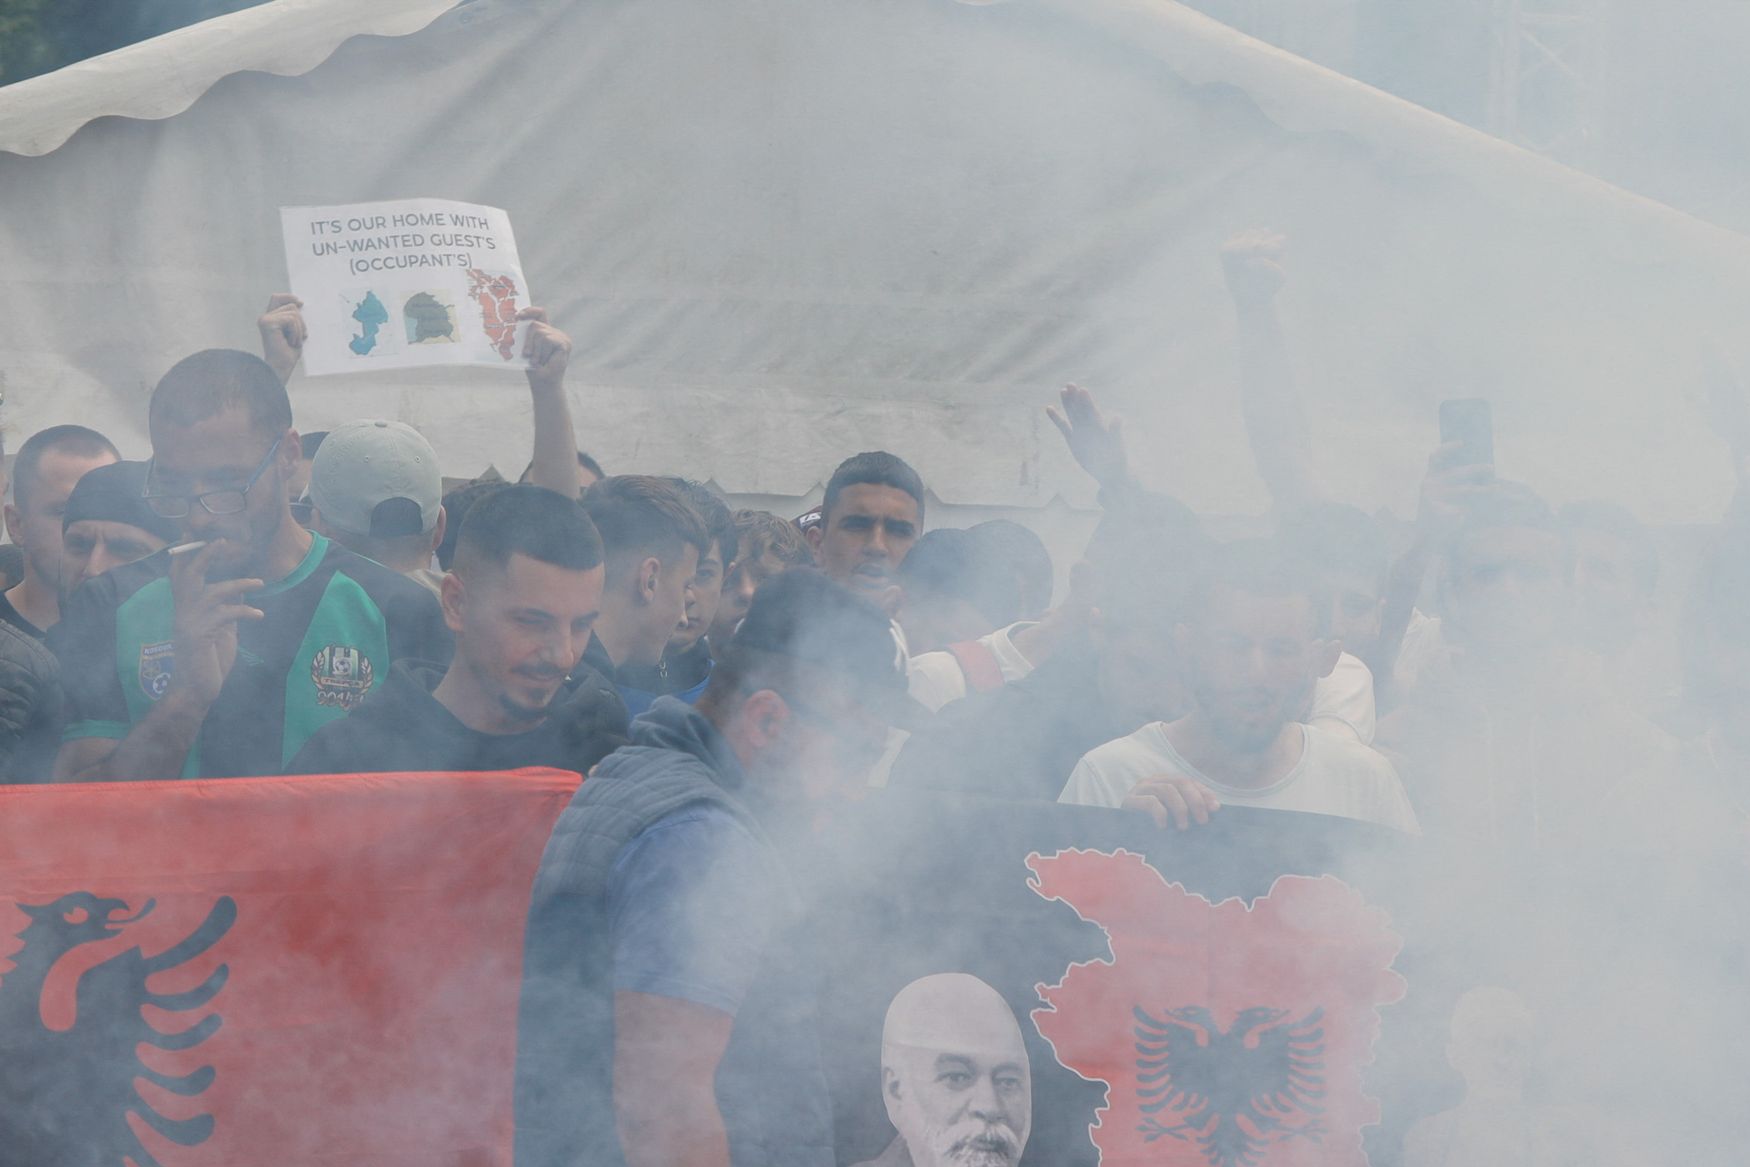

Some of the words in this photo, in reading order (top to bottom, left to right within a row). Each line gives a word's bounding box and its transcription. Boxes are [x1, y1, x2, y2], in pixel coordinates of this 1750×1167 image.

[310, 219, 342, 235] IT'S
[347, 216, 386, 231] OUR
[392, 212, 445, 228] HOME
[449, 213, 489, 230] WITH
[311, 234, 425, 256] UN-WANTED
[430, 233, 496, 250] GUEST'S
[350, 252, 473, 275] (OCCUPANT'S)
